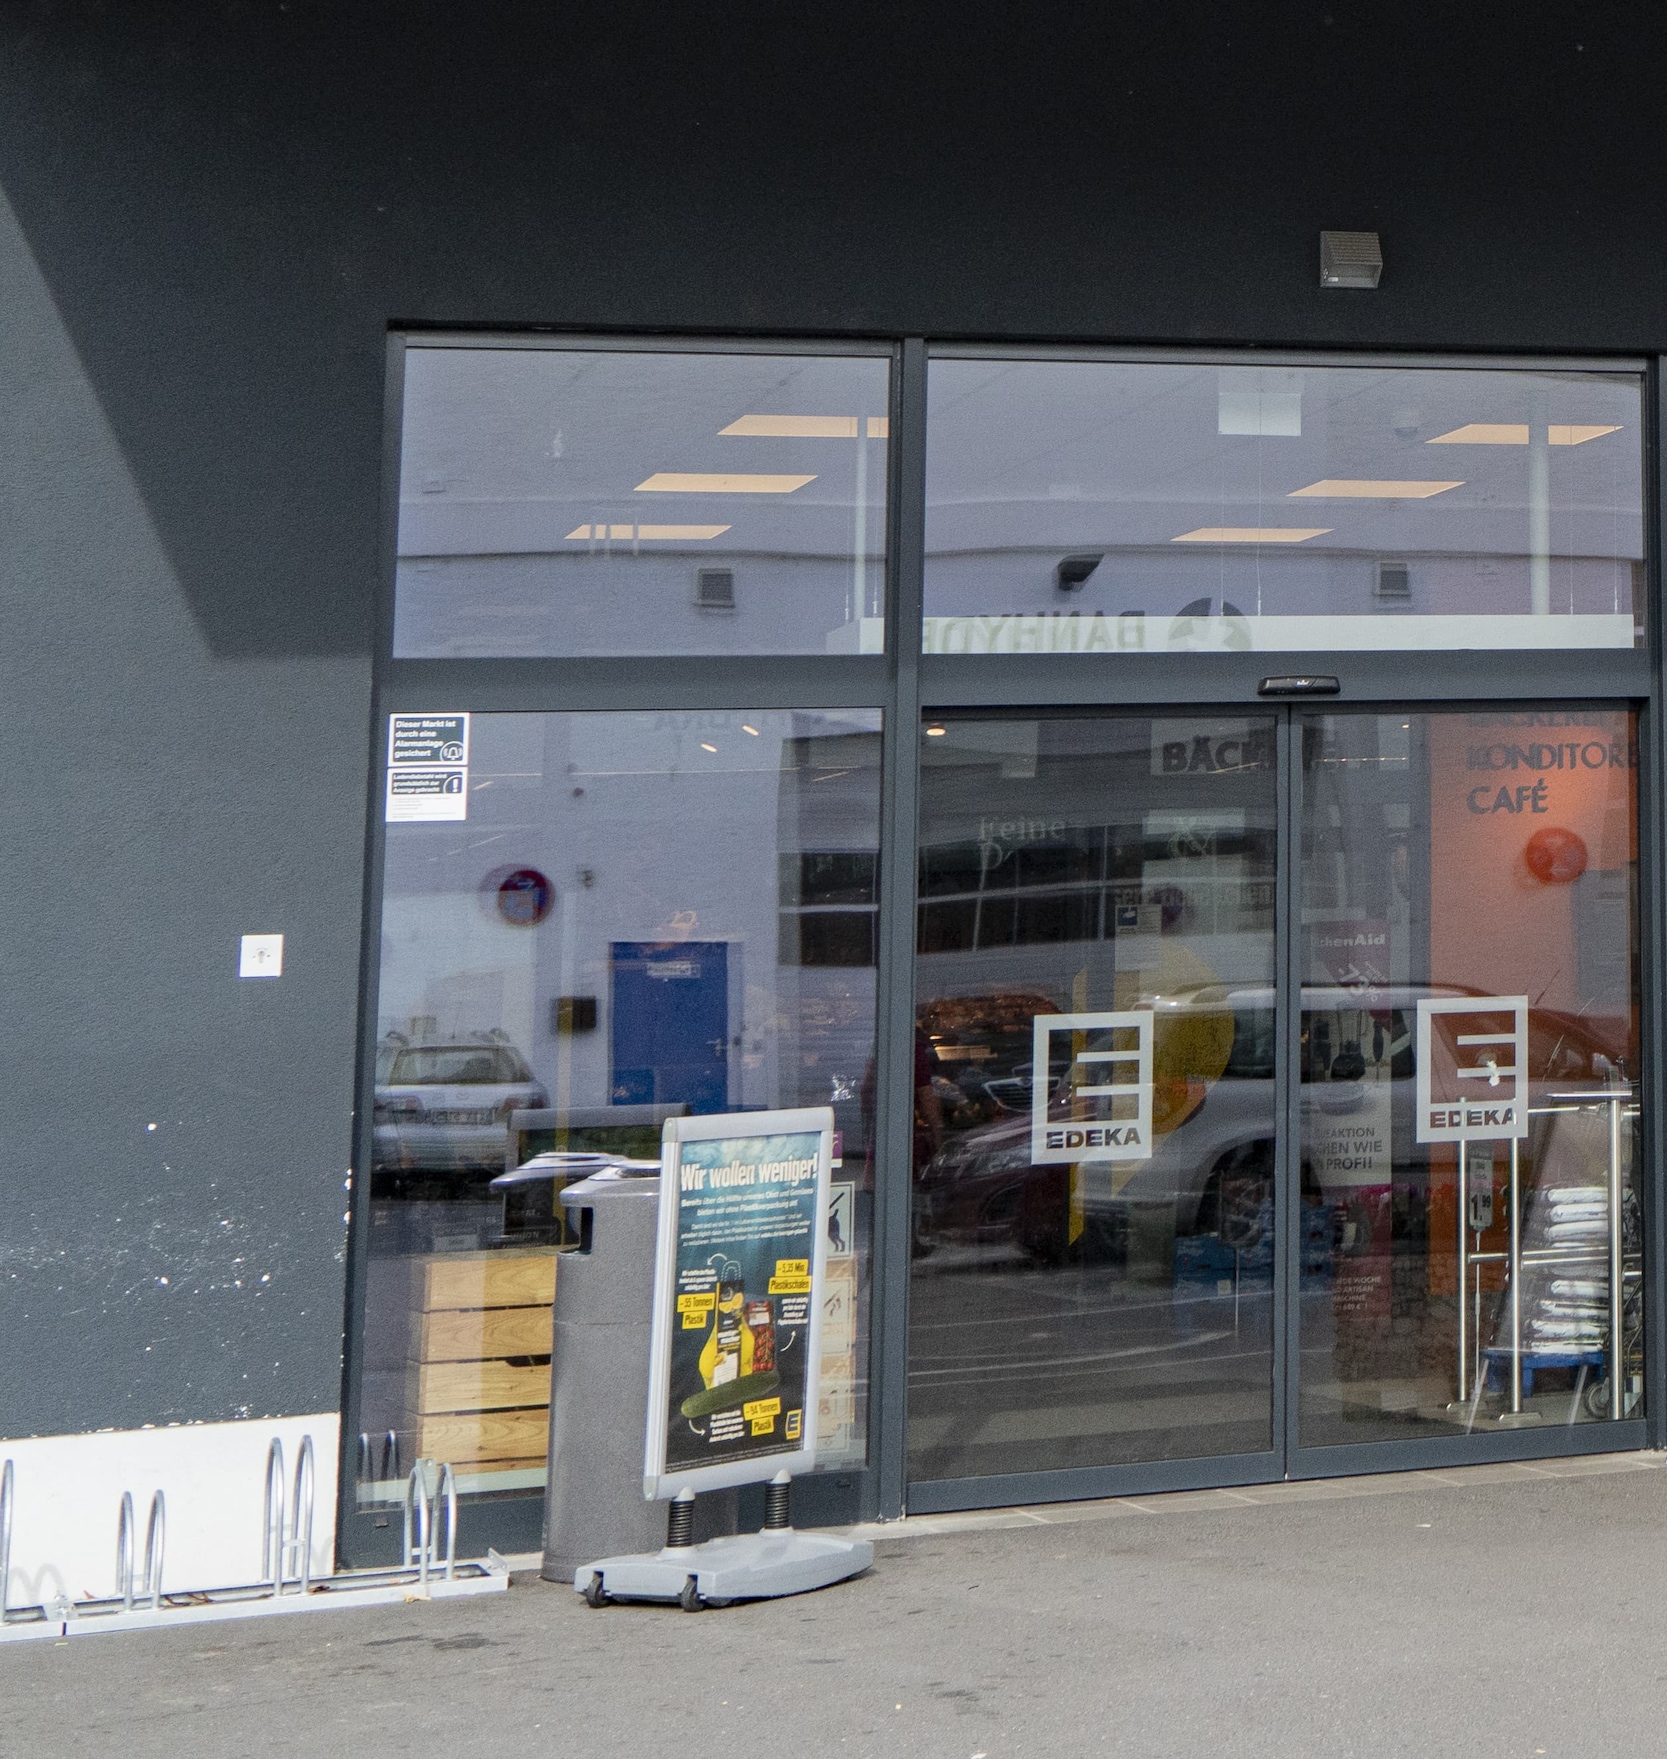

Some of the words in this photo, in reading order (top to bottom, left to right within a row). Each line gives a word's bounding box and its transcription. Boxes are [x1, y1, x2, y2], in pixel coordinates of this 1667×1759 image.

[395, 720, 421, 728] Dieser
[422, 720, 445, 728] Markt
[445, 720, 457, 728] ist
[395, 730, 419, 738] durch
[419, 730, 437, 738] eine
[394, 740, 443, 749] Alarmanlage
[394, 750, 431, 759] gesichert
[1466, 778, 1549, 815] CAFÉ
[1430, 1107, 1516, 1129] EDEKA
[1046, 1127, 1141, 1149] EDEKA
[1353, 1140, 1383, 1153] WIE
[1325, 1157, 1373, 1171] PROFI!
[681, 1164, 707, 1191] Wir
[709, 1159, 756, 1189] wollen
[758, 1152, 819, 1186] weniger!
[770, 1279, 810, 1291] Plastikschalen
[693, 1294, 713, 1307] Tonnen
[684, 1312, 704, 1325] Plastik
[758, 1402, 778, 1414] Tonnen
[754, 1419, 772, 1433] Plastik
